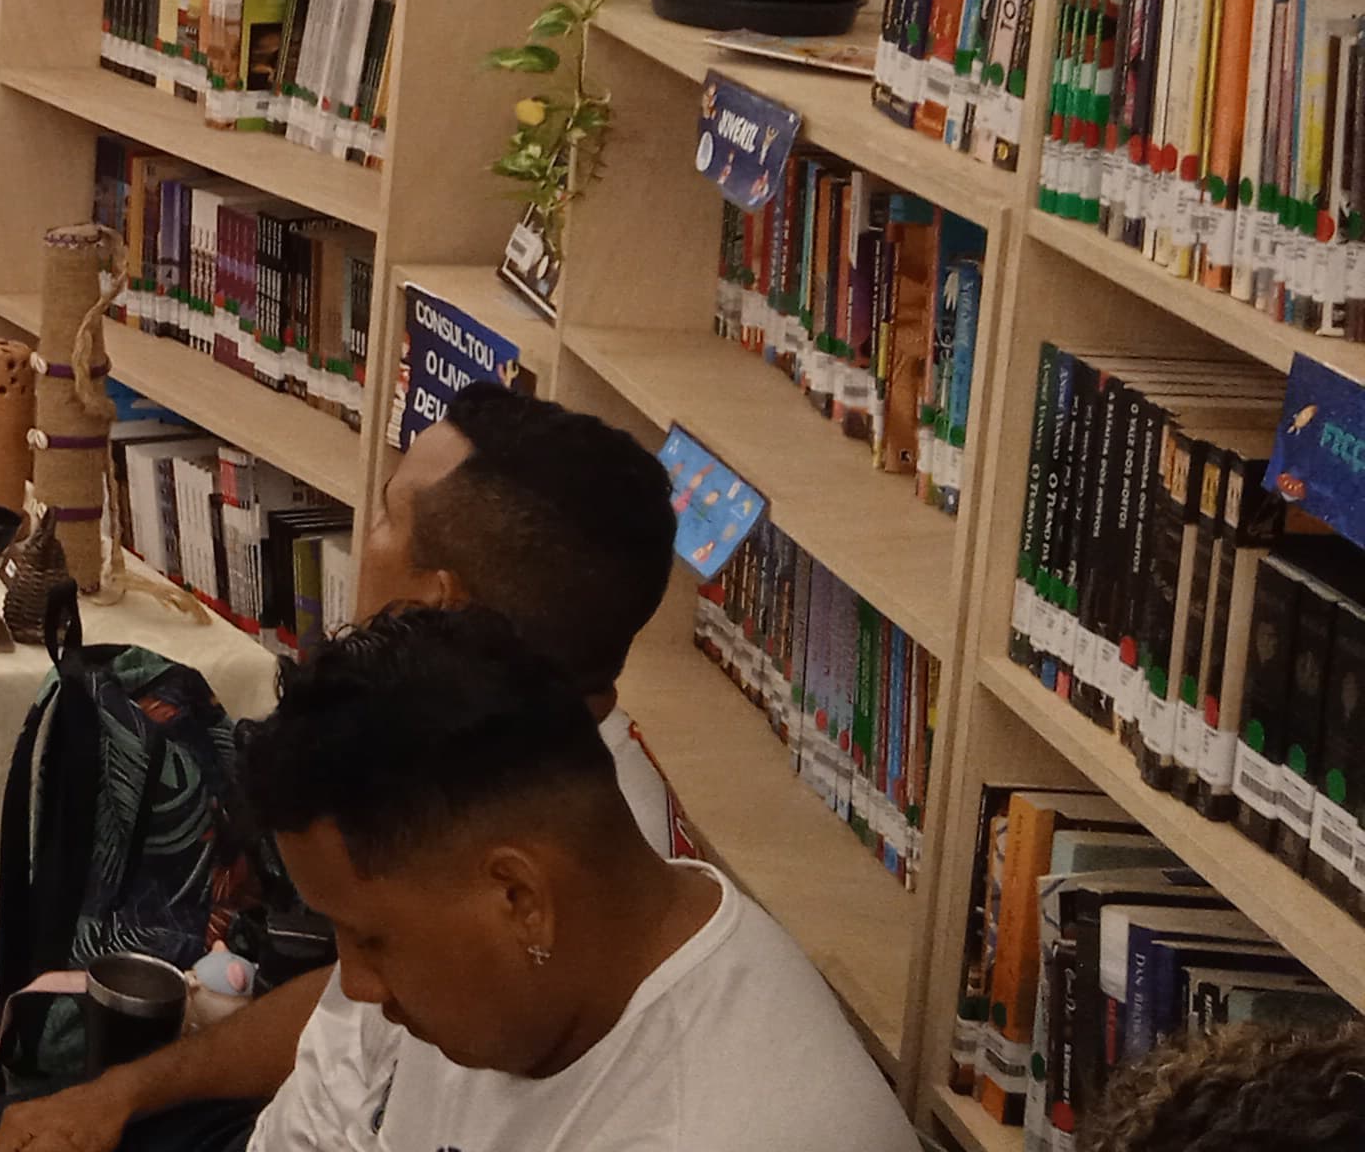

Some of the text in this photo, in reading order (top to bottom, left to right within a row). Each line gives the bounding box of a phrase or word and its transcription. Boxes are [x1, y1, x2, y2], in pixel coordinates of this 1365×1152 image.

[718, 109, 759, 153] JUVENIL
[415, 299, 494, 372] CONSULTOU
[426, 350, 438, 376] O
